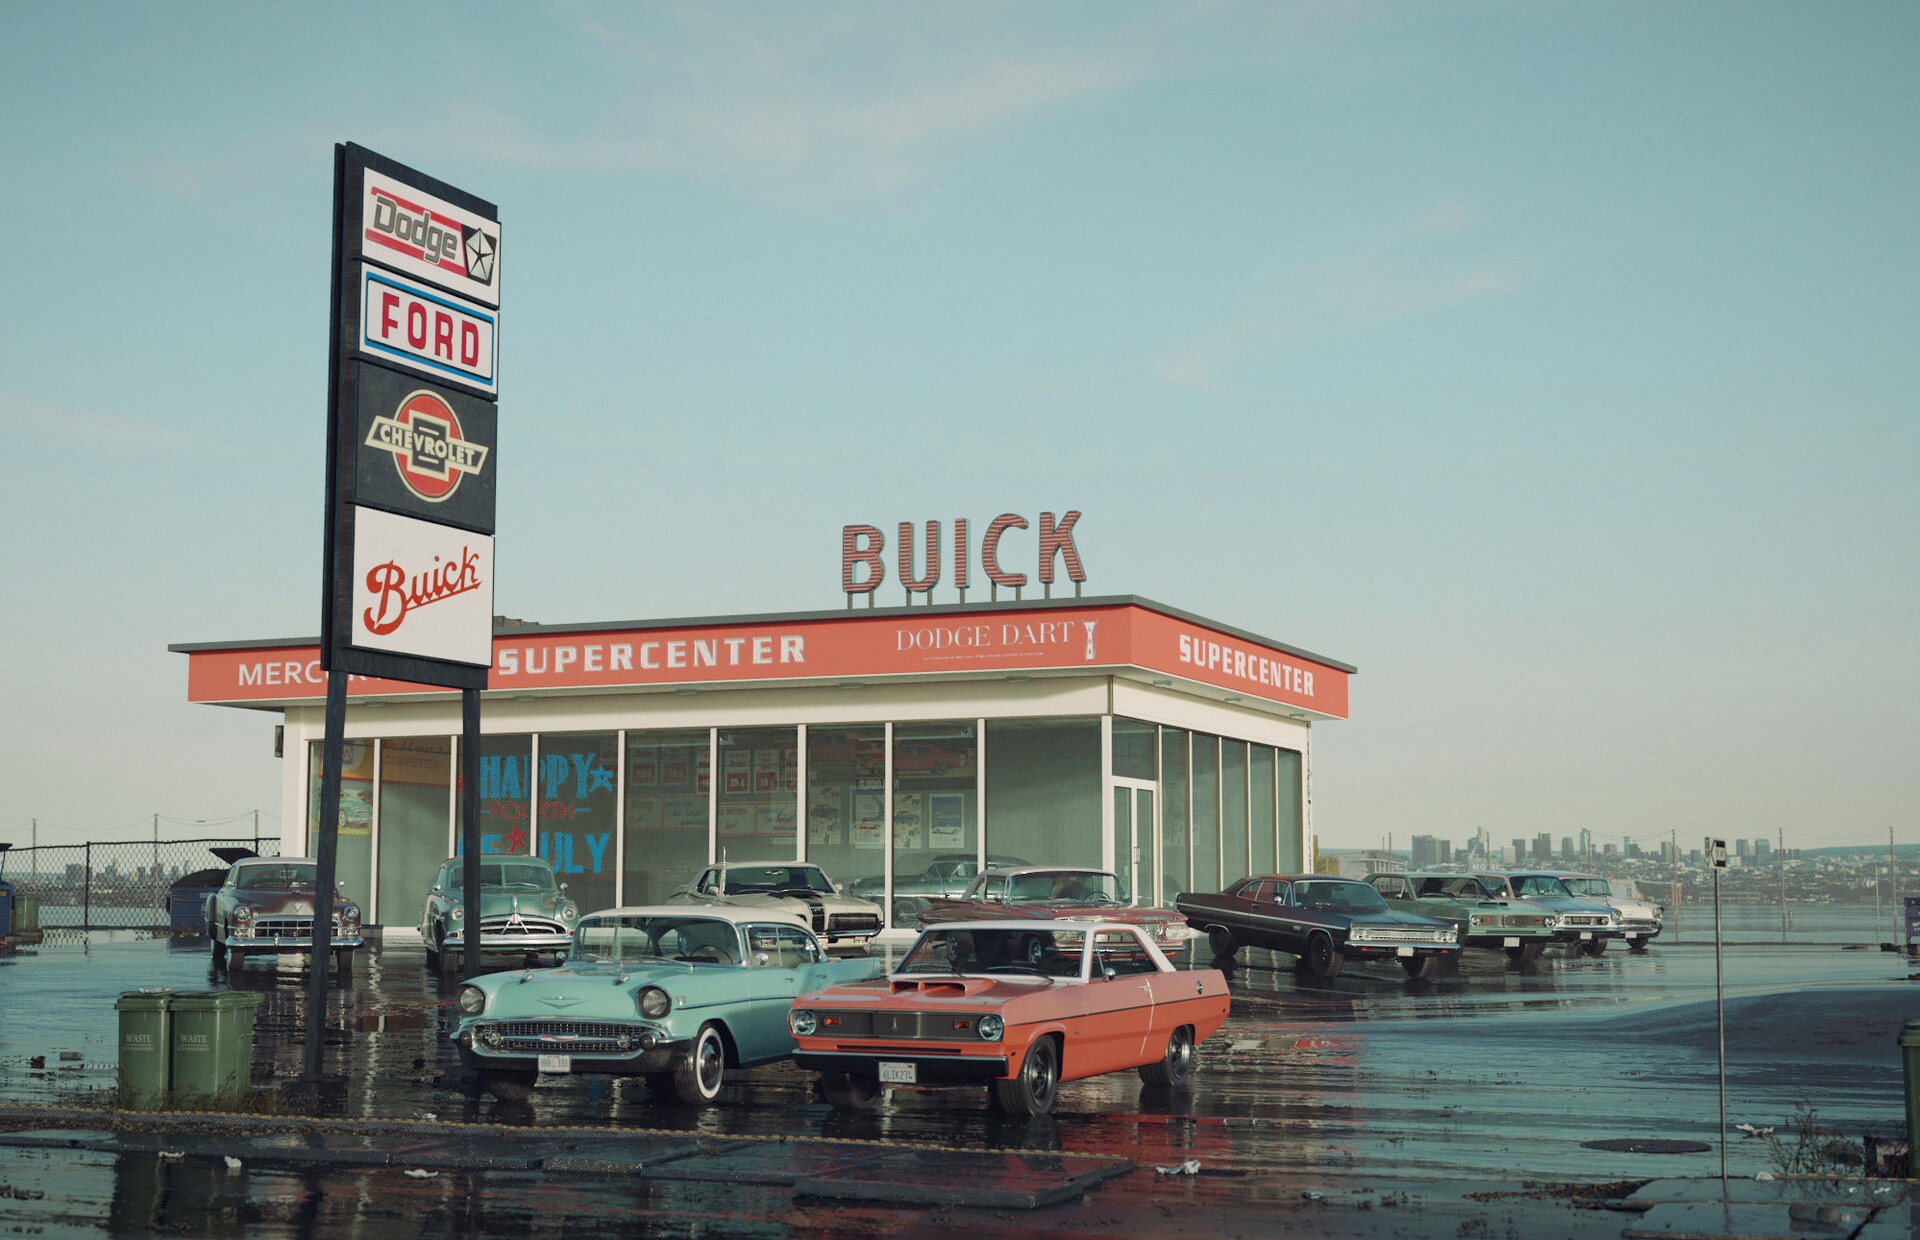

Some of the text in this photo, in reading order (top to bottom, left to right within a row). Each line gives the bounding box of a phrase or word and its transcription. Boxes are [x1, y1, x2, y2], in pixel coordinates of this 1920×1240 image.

[374, 195, 457, 264] Dodge
[381, 291, 479, 367] FORD
[379, 424, 475, 467] CHEVROLET
[842, 510, 1087, 594] BUICK
[363, 546, 482, 635] Buick
[498, 635, 806, 675] SUPERCENTER
[896, 621, 1075, 651] DODGE DART
[1179, 634, 1315, 697] SUPERCENTER
[125, 1034, 152, 1043] WASTE
[180, 1034, 207, 1043] WASTE
